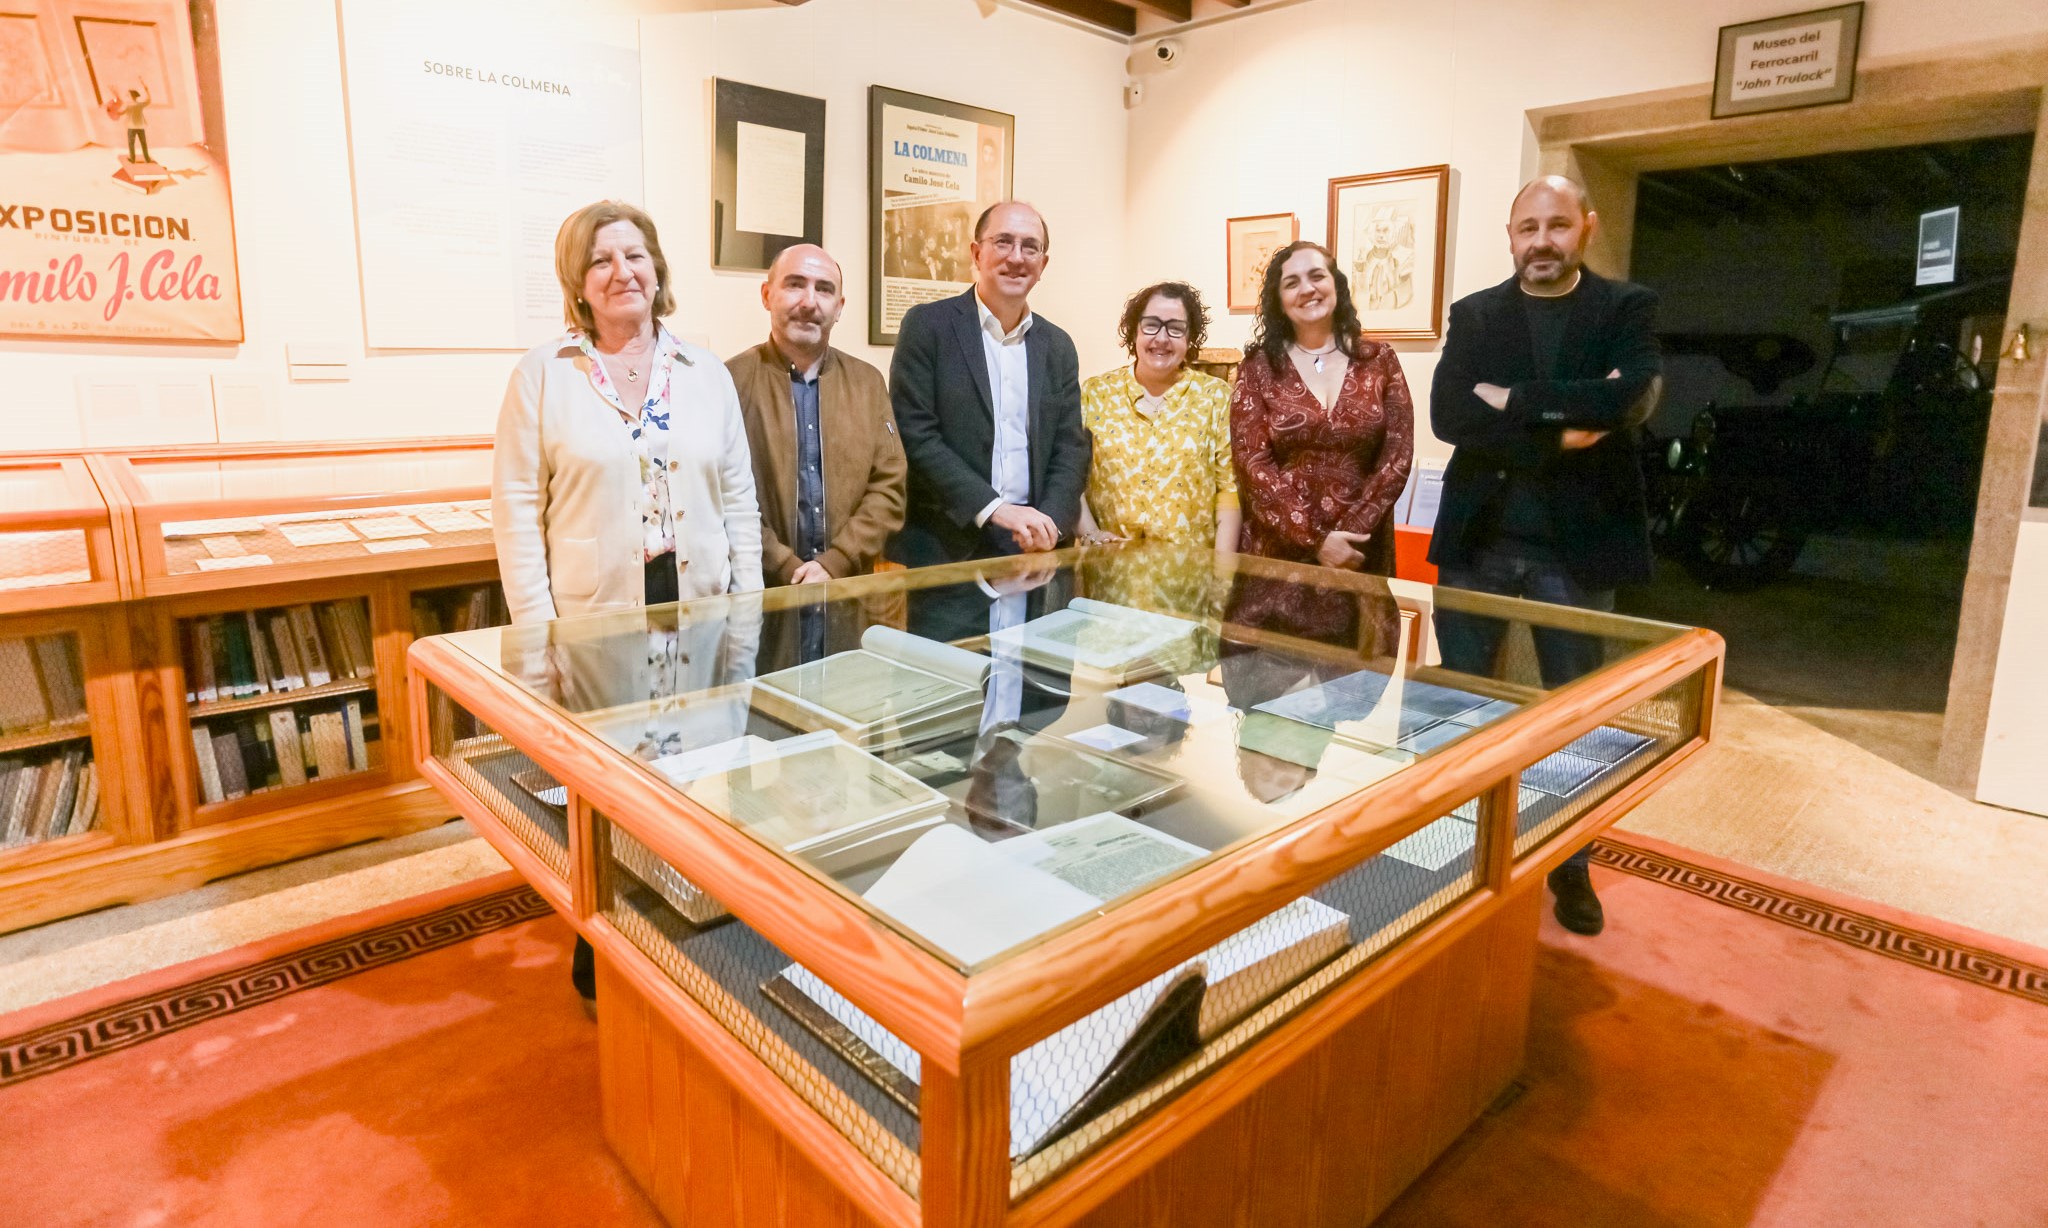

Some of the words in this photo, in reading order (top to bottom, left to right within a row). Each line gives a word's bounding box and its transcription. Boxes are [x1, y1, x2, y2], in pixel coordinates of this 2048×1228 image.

[1752, 37, 1796, 51] Museo
[1799, 31, 1821, 44] del
[1750, 50, 1819, 70] Ferrocarril
[424, 61, 473, 80] SOBRE
[478, 70, 497, 84] LA
[501, 75, 571, 96] COLMENA
[894, 140, 910, 157] LA
[912, 144, 968, 167] COLMENA
[903, 173, 928, 186] Camilo
[945, 180, 960, 191] Cela
[140, 249, 222, 301] Cela
